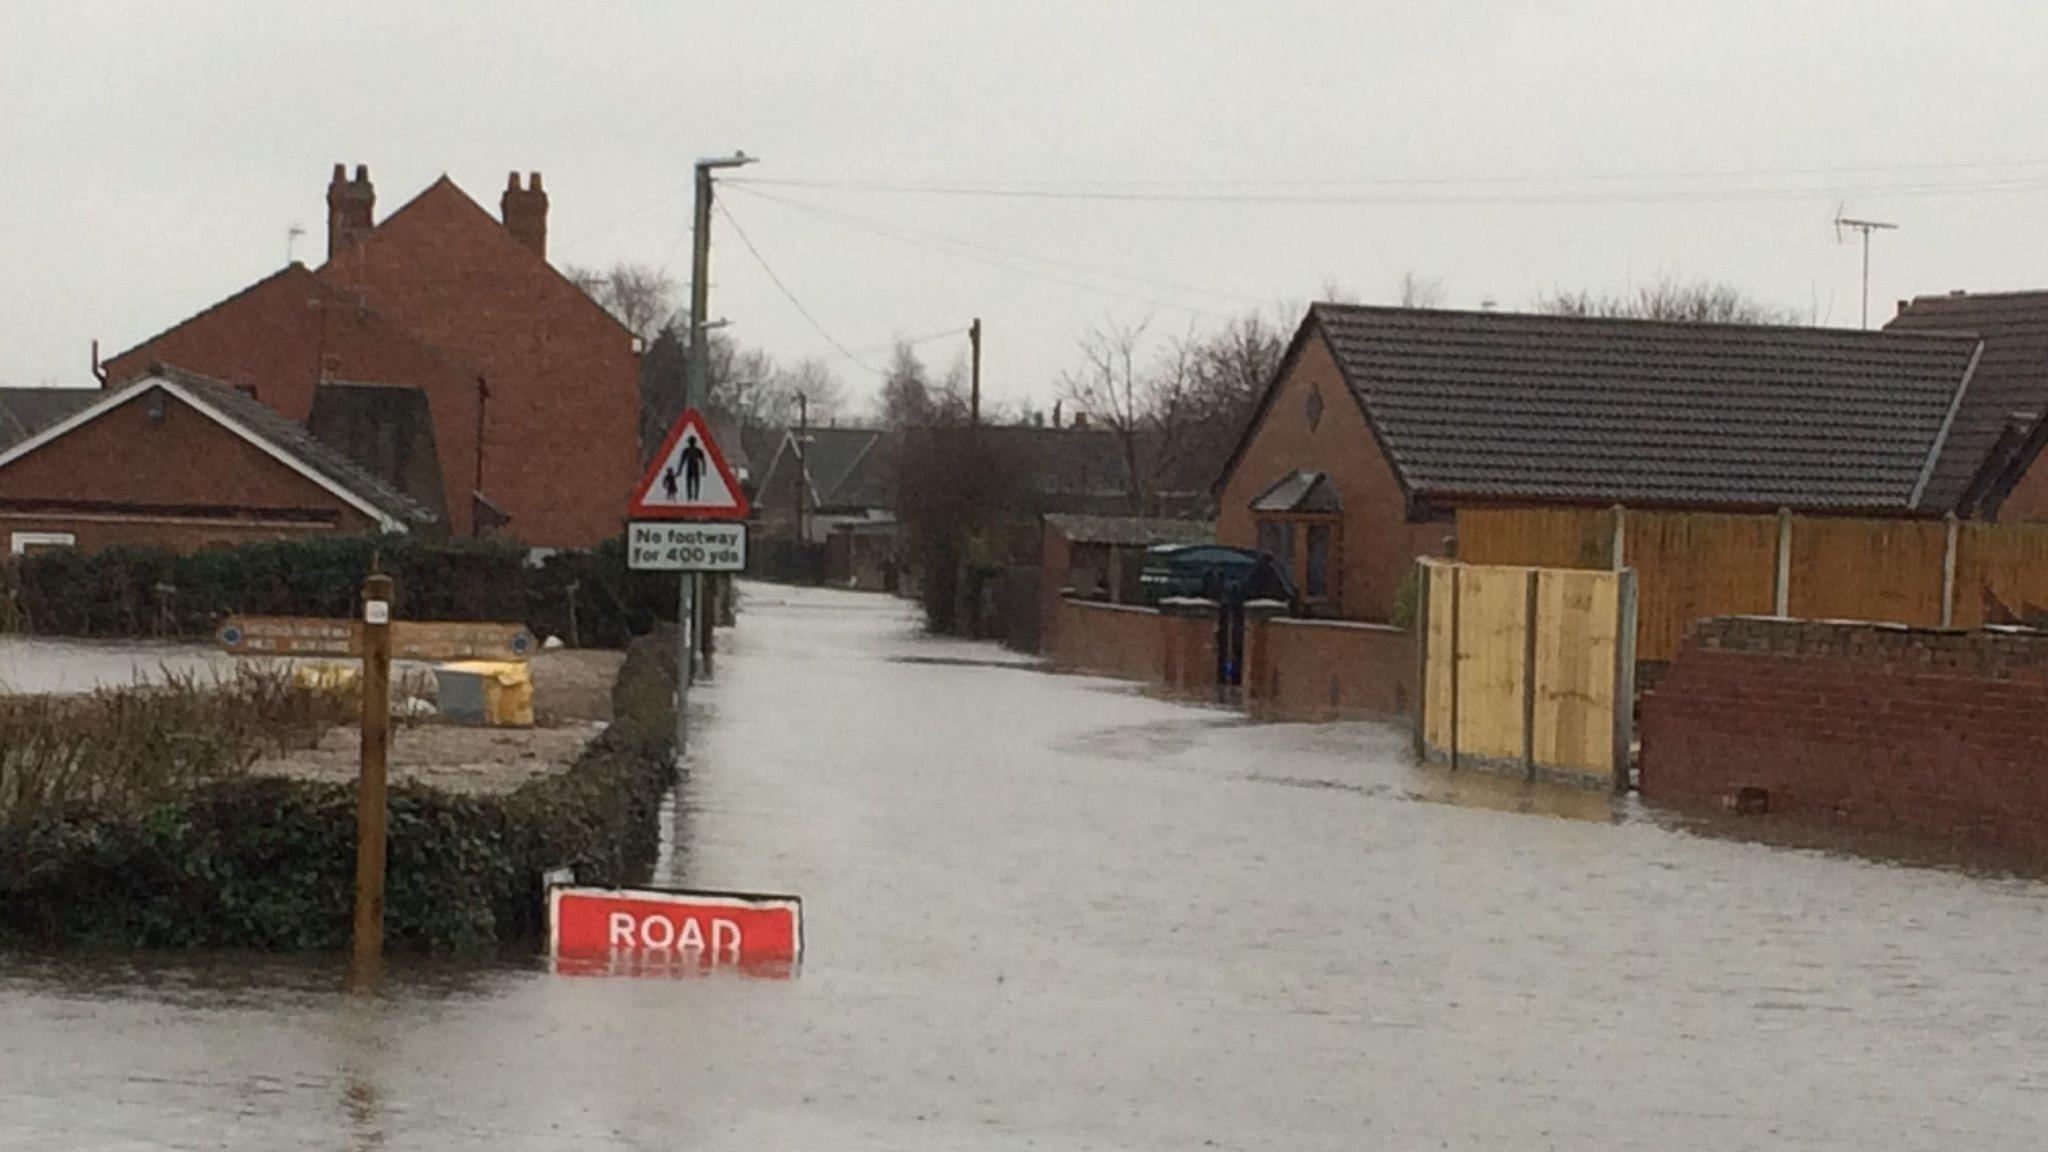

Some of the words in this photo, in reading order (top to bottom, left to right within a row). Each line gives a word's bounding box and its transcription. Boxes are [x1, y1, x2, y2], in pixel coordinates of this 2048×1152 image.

[636, 529, 662, 545] No
[667, 529, 738, 547] footway
[633, 547, 660, 564] for
[666, 547, 705, 562] 400
[709, 549, 739, 565] yds
[609, 912, 742, 950] ROAD
